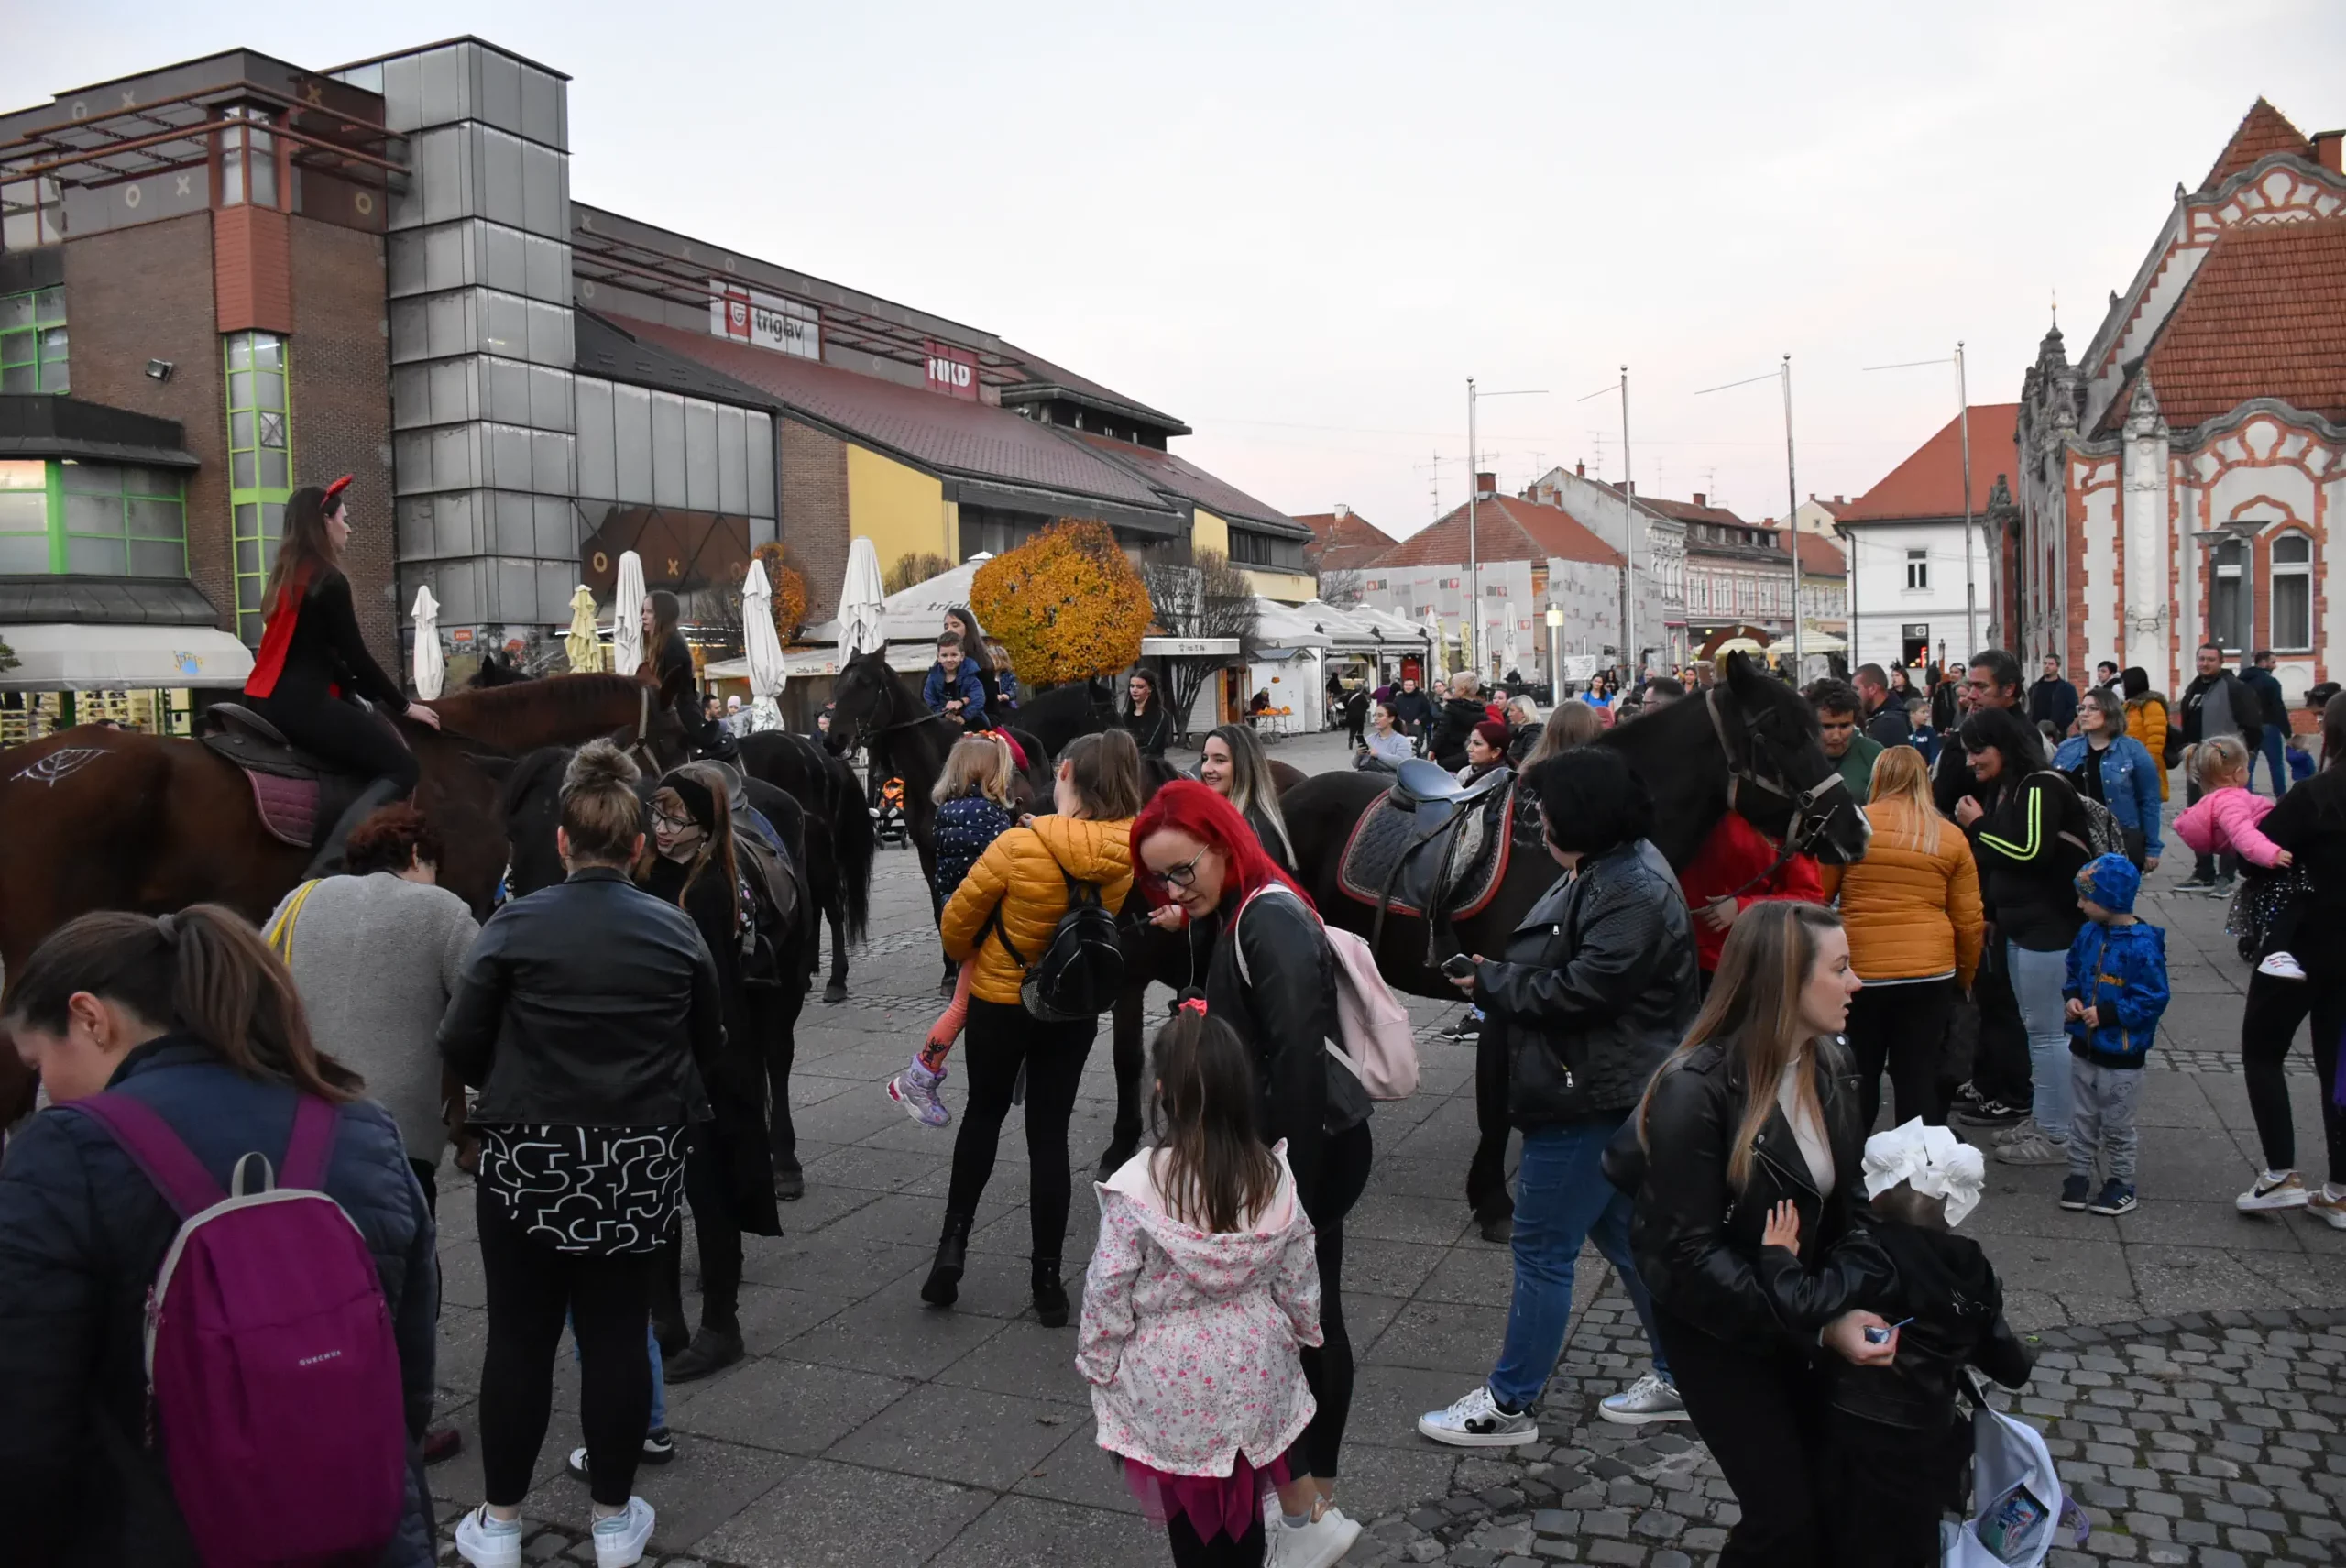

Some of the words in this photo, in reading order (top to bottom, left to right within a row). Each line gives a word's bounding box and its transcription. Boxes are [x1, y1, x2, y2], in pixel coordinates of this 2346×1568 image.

[756, 309, 804, 343] triglav
[928, 356, 970, 387] NKD
[299, 1350, 342, 1366] QUECHUA
